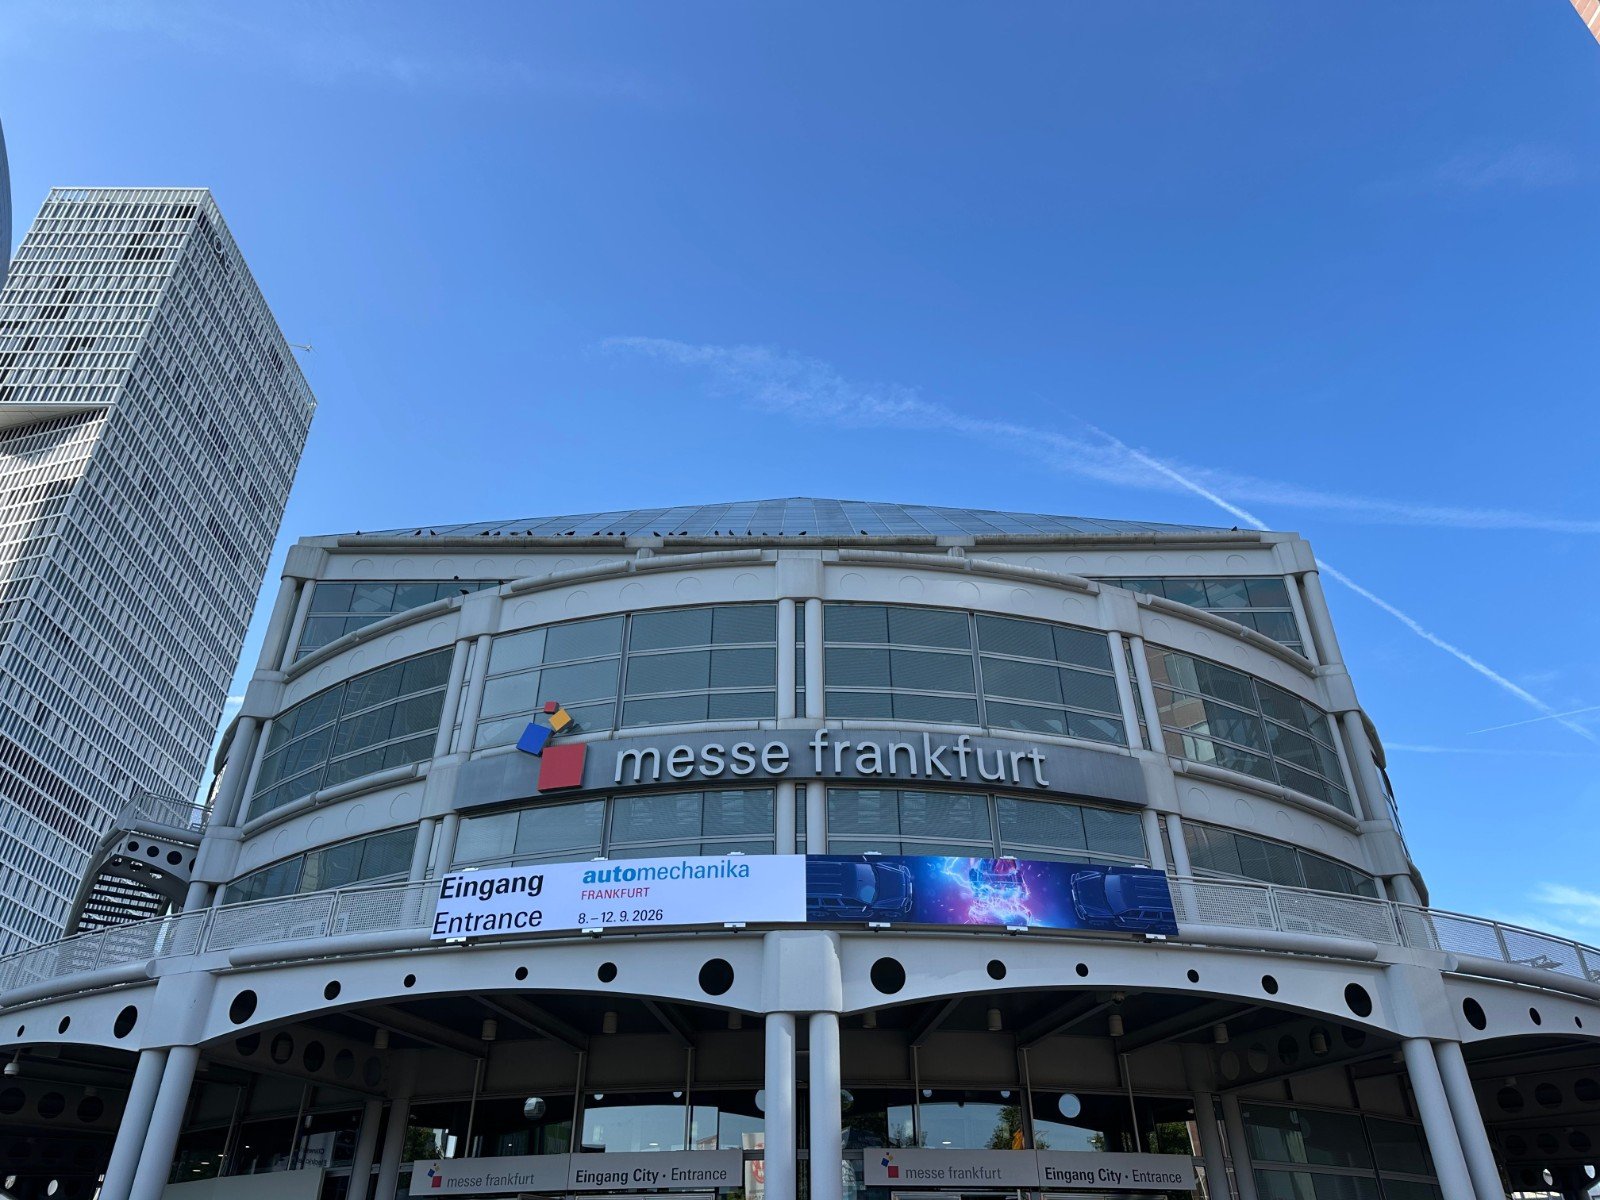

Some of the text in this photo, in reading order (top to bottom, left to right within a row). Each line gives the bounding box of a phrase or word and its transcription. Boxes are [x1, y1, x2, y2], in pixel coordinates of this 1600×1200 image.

[614, 729, 1049, 787] messe frankfurt
[582, 860, 750, 884] automechanika
[439, 874, 544, 901] Eingang
[581, 887, 650, 900] FRANKFURT
[432, 909, 542, 935] Entrance
[447, 1173, 534, 1188] messe frankfurt
[575, 1167, 727, 1185] Eingang City Entrance
[905, 1166, 1002, 1179] messe frankfurt
[1045, 1167, 1182, 1184] Eingang City Entrance
